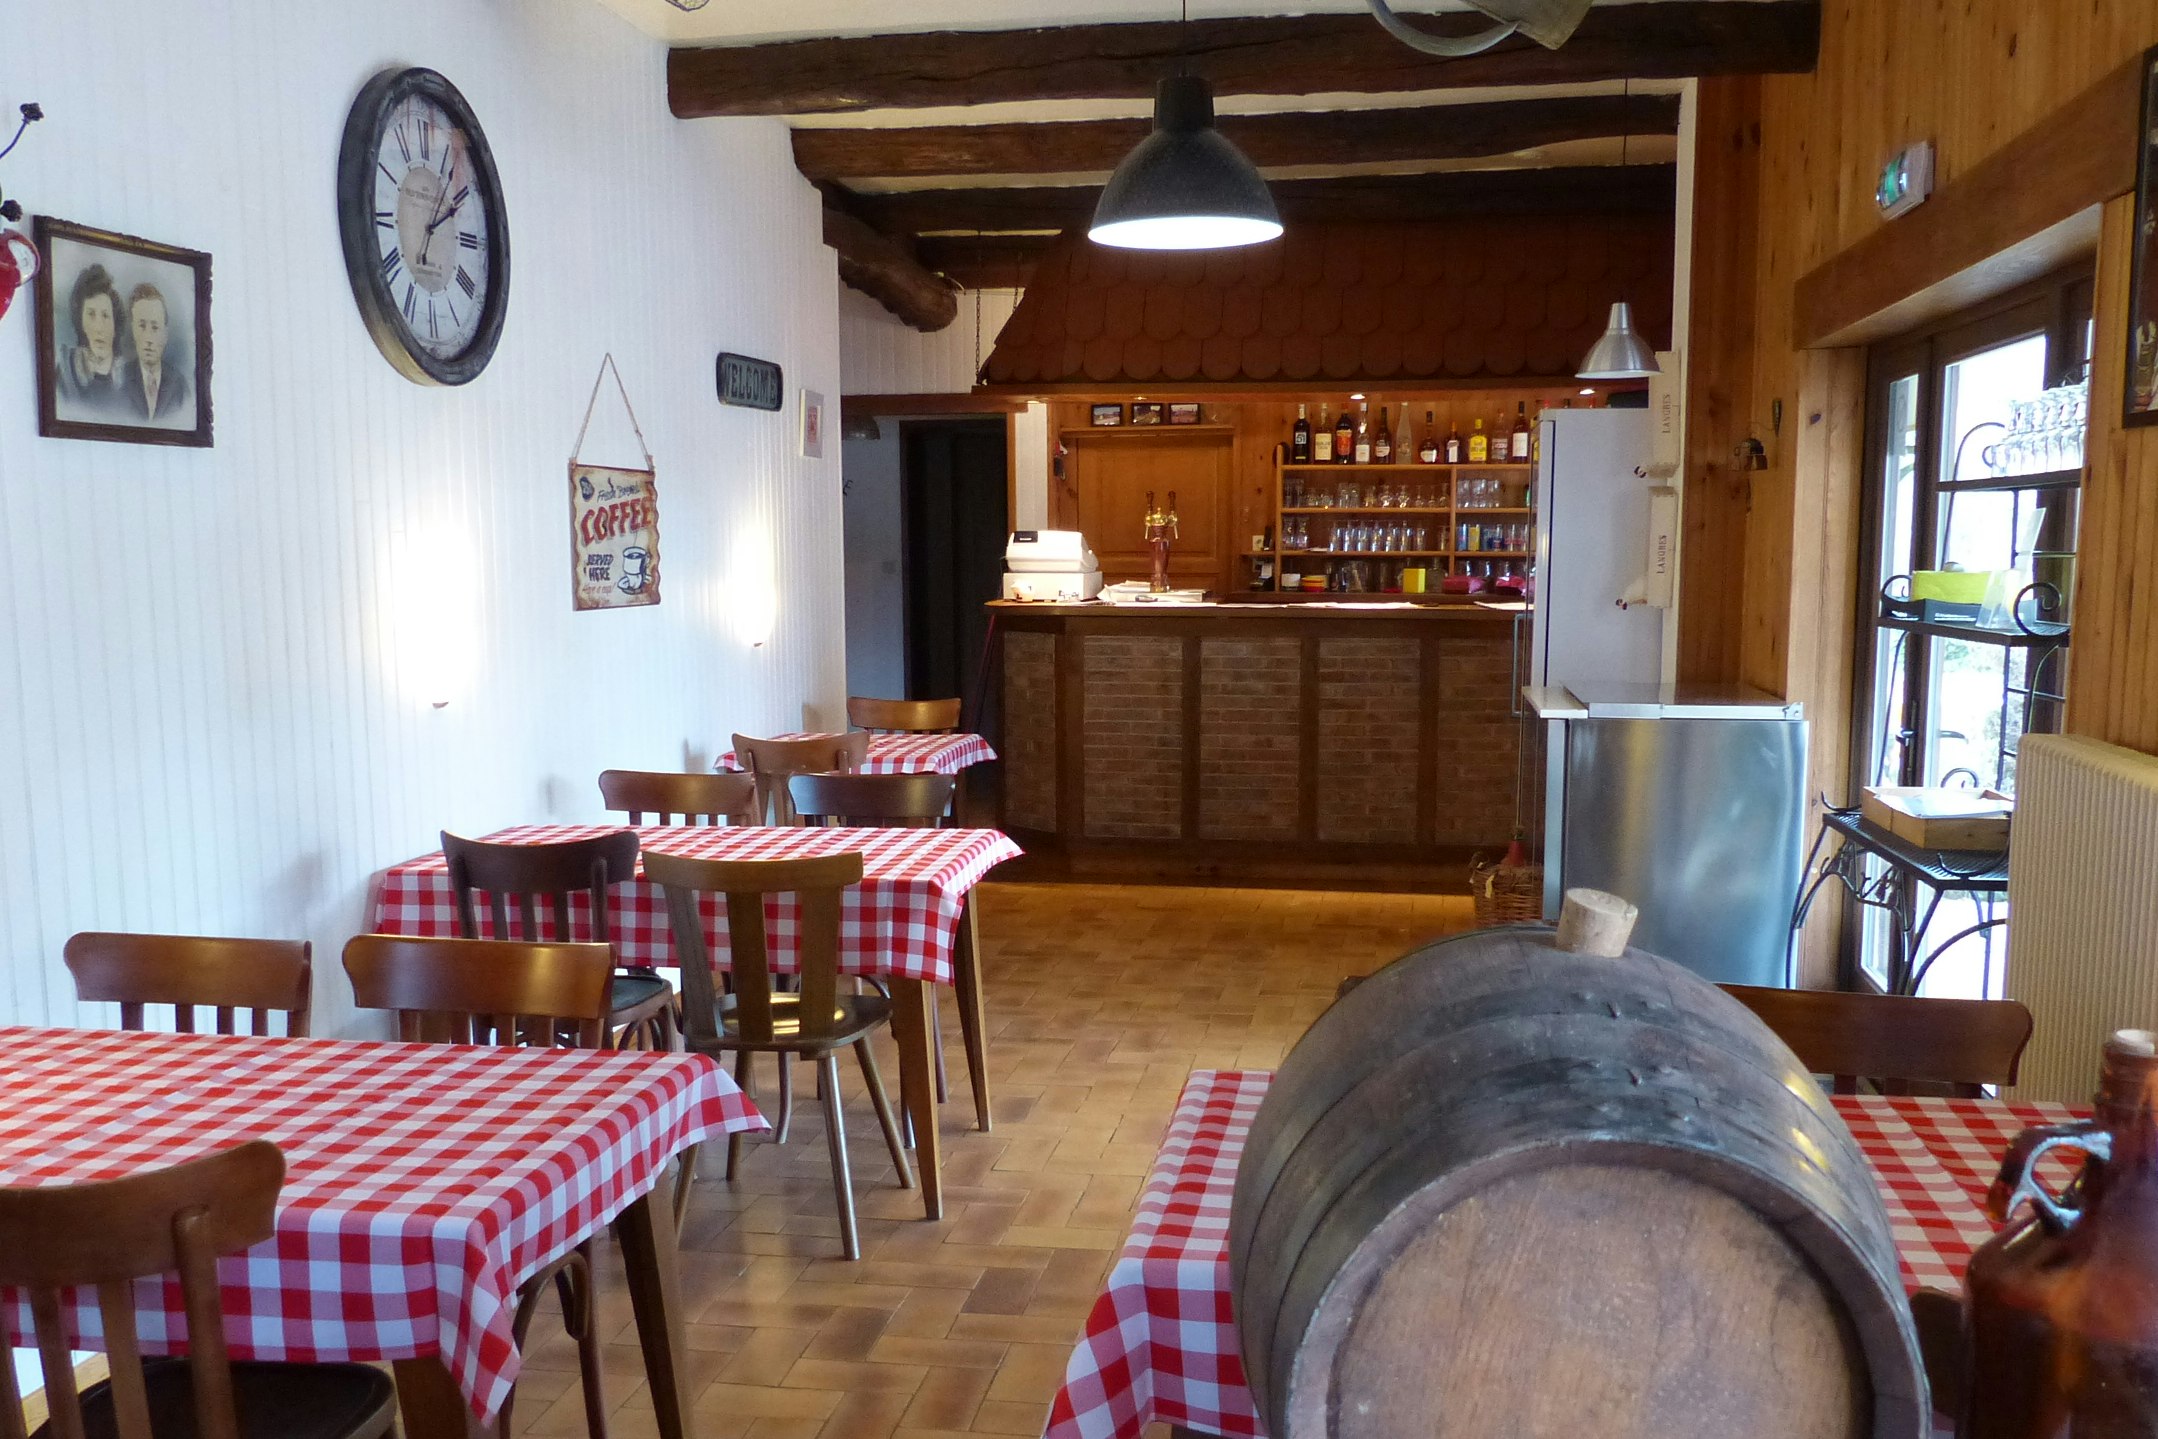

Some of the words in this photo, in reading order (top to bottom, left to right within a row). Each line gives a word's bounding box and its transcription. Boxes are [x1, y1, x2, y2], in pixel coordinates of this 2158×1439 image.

[723, 362, 776, 404] WELCOME
[581, 496, 652, 546] COFFEE
[586, 554, 614, 566] SERVED
[589, 567, 610, 582] HERE
